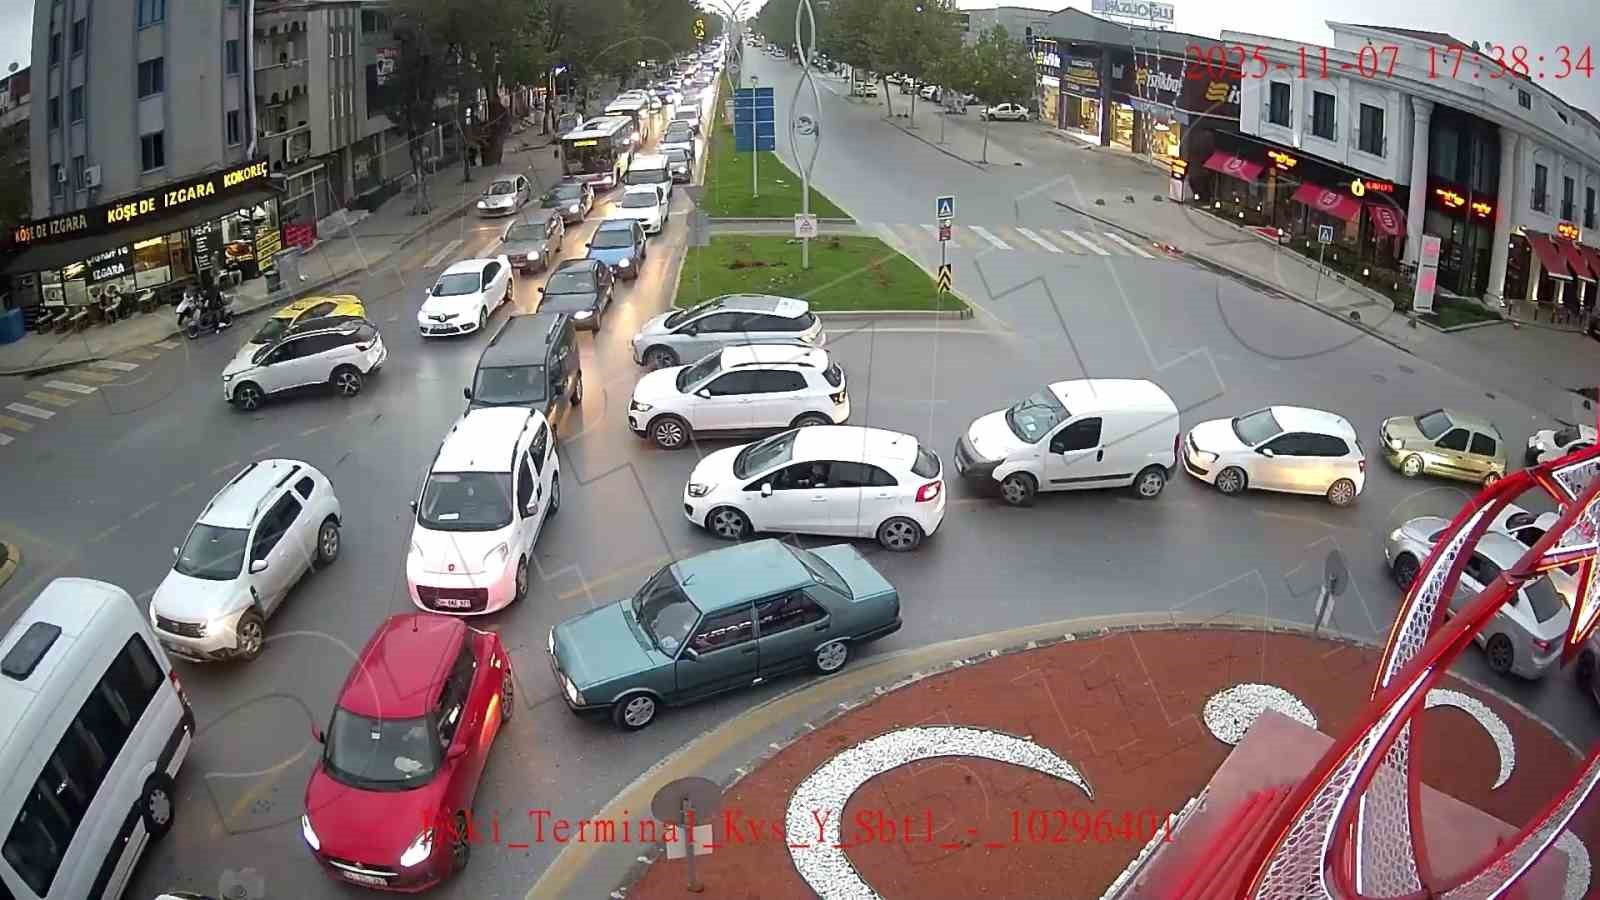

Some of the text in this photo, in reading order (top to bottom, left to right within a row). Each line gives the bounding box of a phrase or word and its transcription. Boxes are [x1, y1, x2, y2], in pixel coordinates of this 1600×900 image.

[107, 162, 268, 223] KÖŞE DE IZGARA KOKOREÇ
[50, 214, 87, 235] IZGARA
